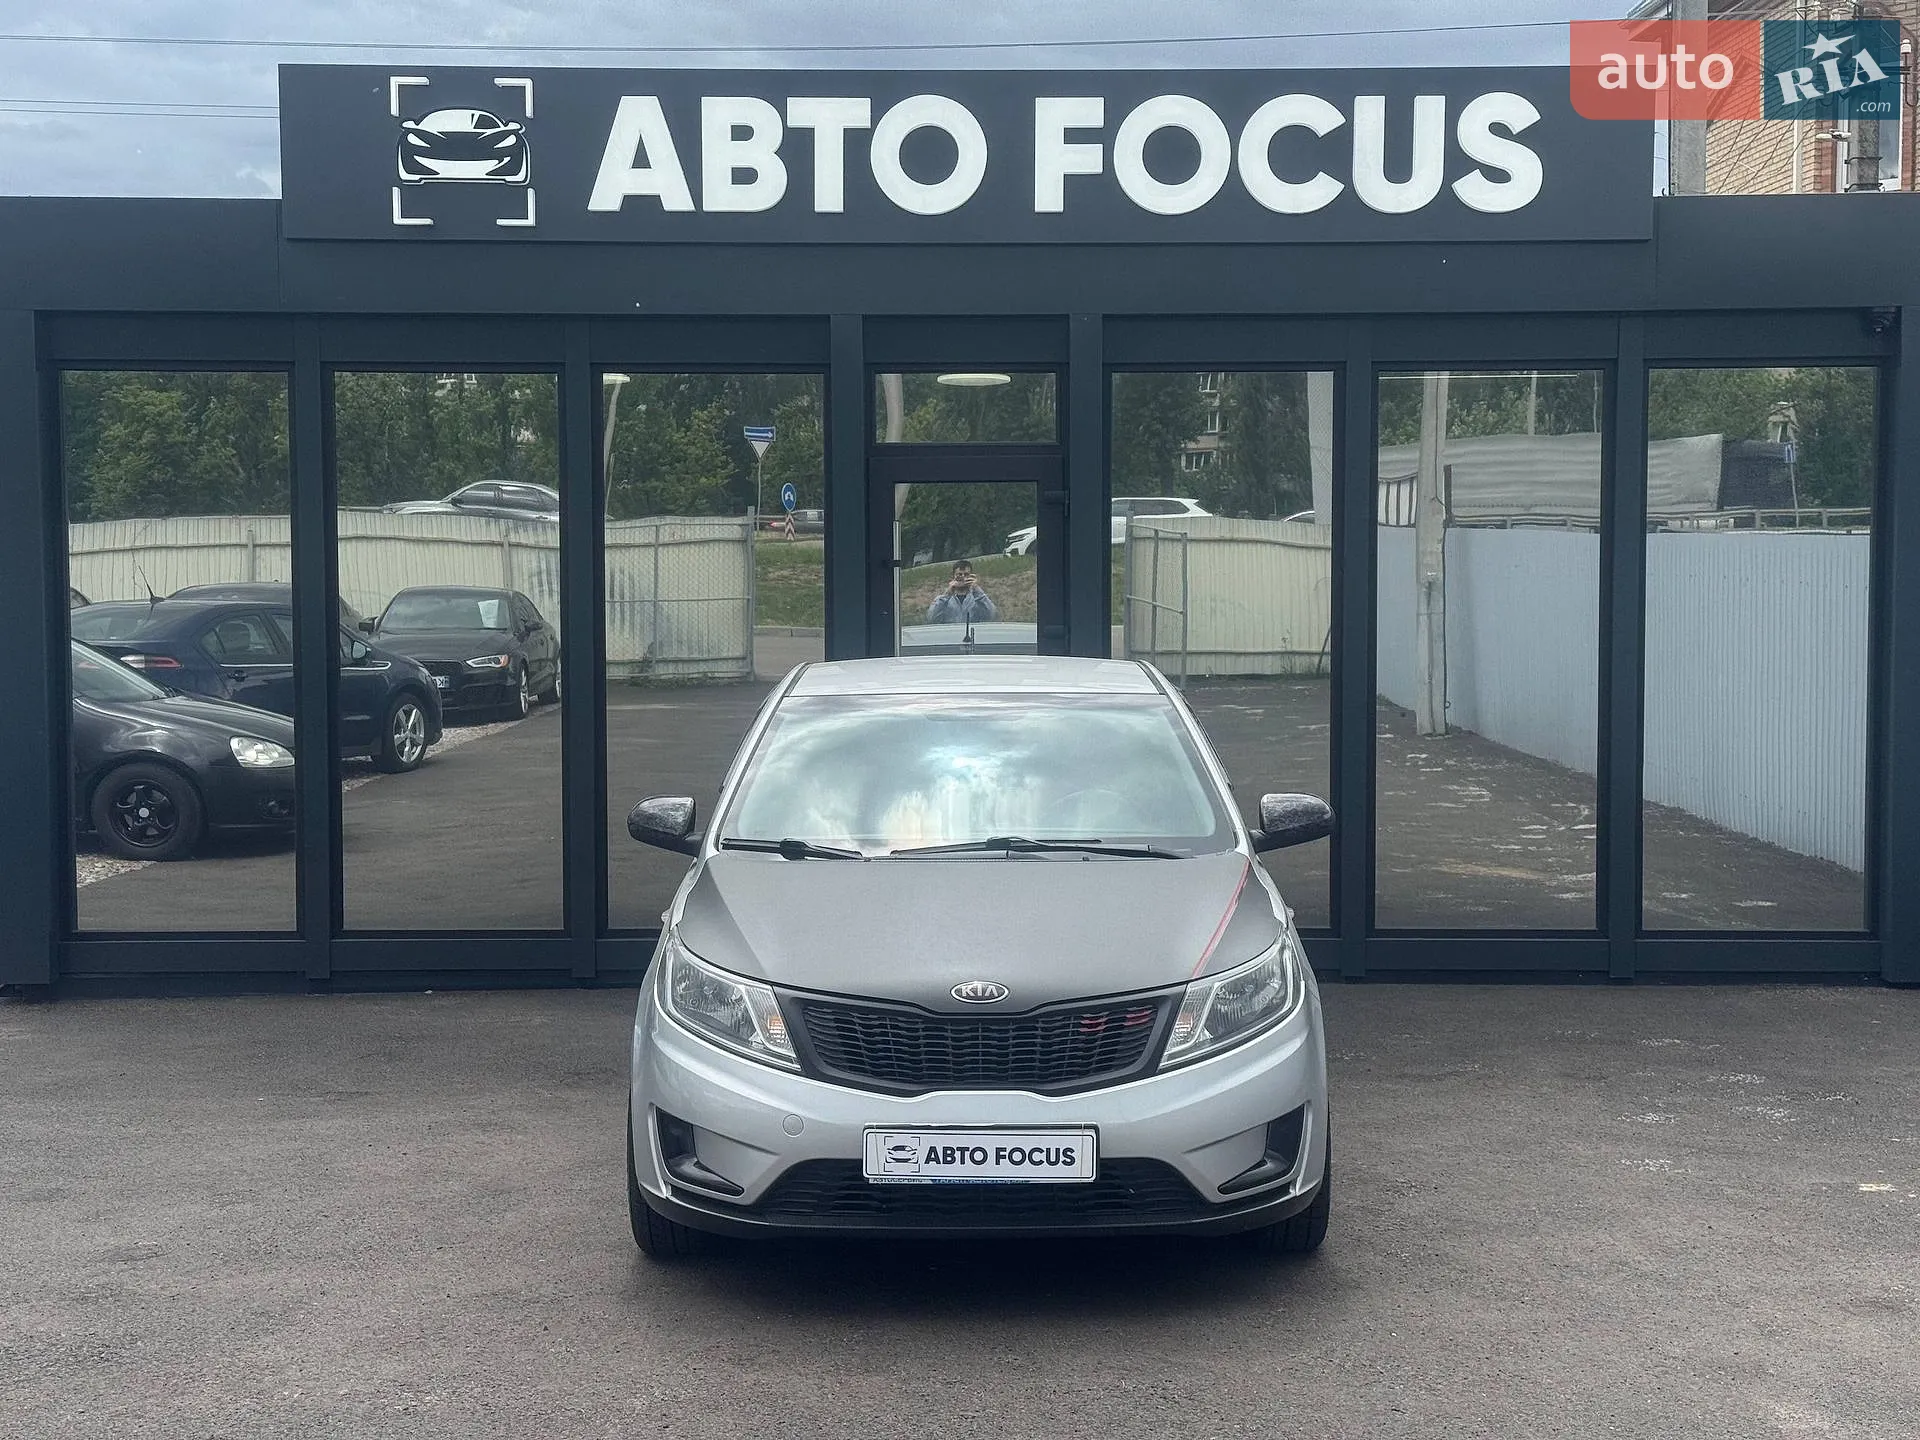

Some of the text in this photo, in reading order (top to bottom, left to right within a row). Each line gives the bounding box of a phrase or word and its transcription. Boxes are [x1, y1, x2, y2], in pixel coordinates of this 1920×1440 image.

[587, 92, 1543, 215] АВТО FOCUS
[961, 984, 998, 997] KIA
[924, 1146, 1076, 1167] АВТО FOCUS
